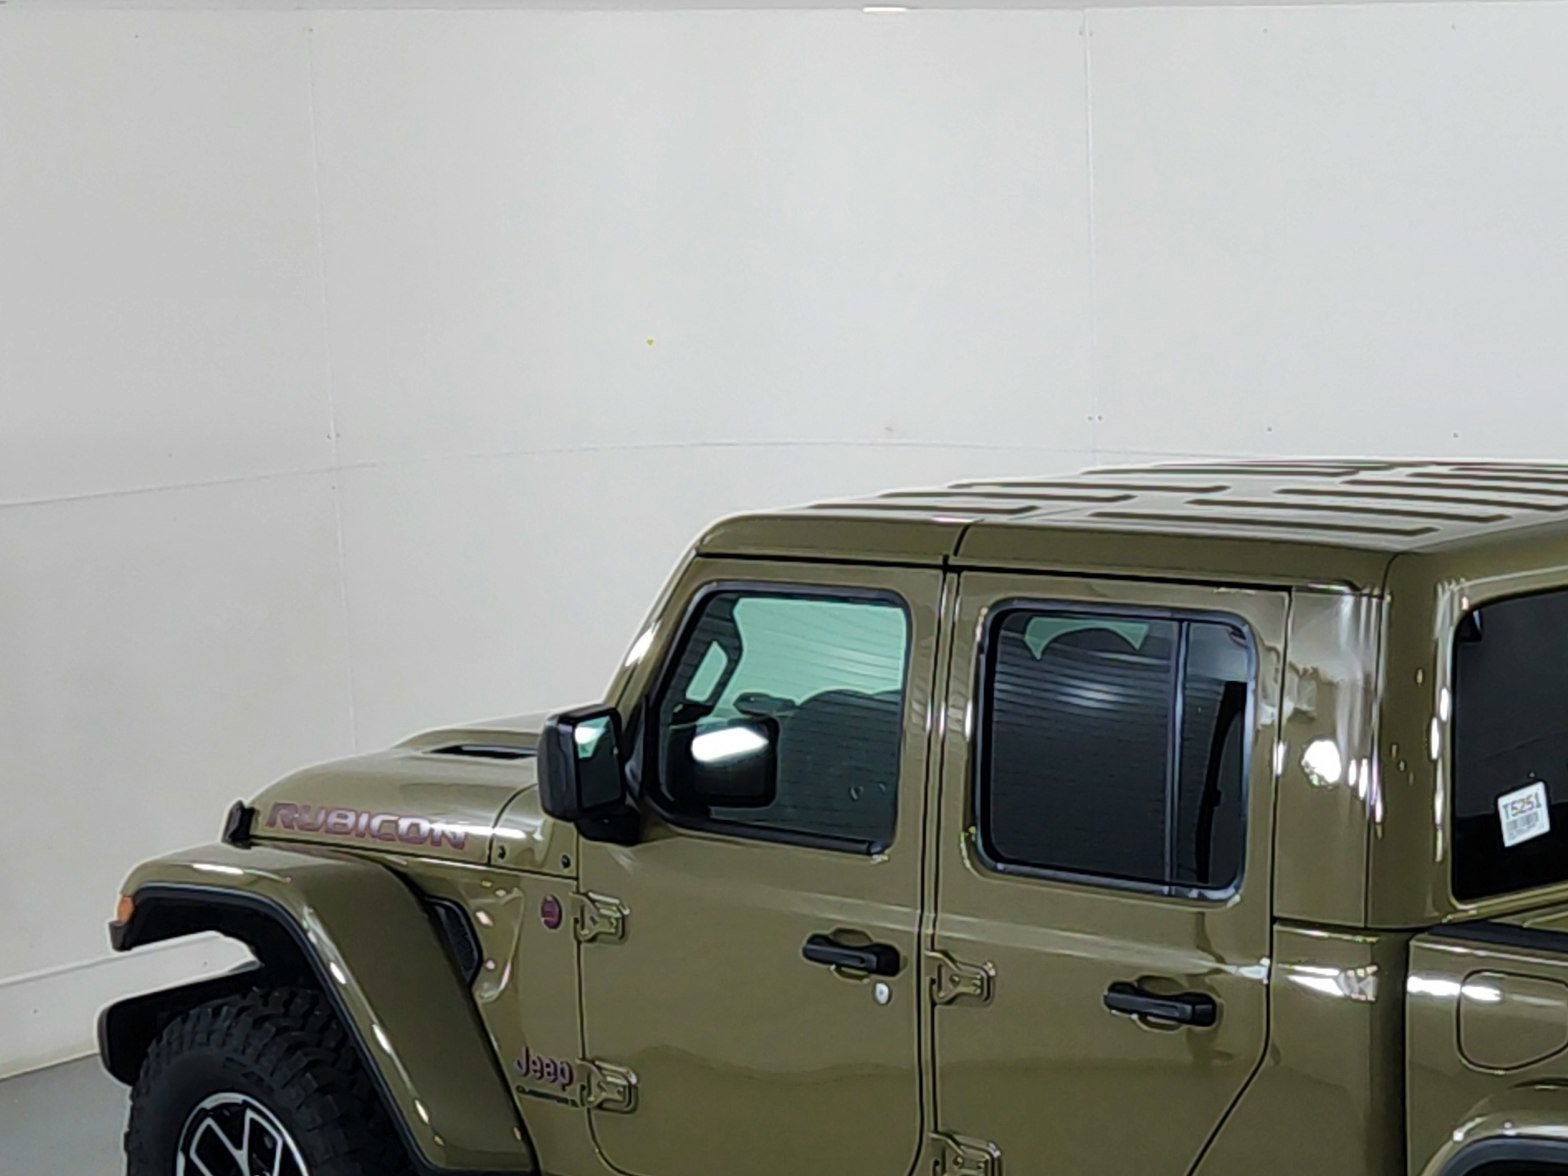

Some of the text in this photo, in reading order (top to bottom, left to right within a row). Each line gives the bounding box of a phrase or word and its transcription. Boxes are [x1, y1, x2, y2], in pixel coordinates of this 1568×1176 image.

[266, 802, 467, 850] RUBICON
[1502, 791, 1542, 820] T5251
[514, 1045, 574, 1091] Jeep
